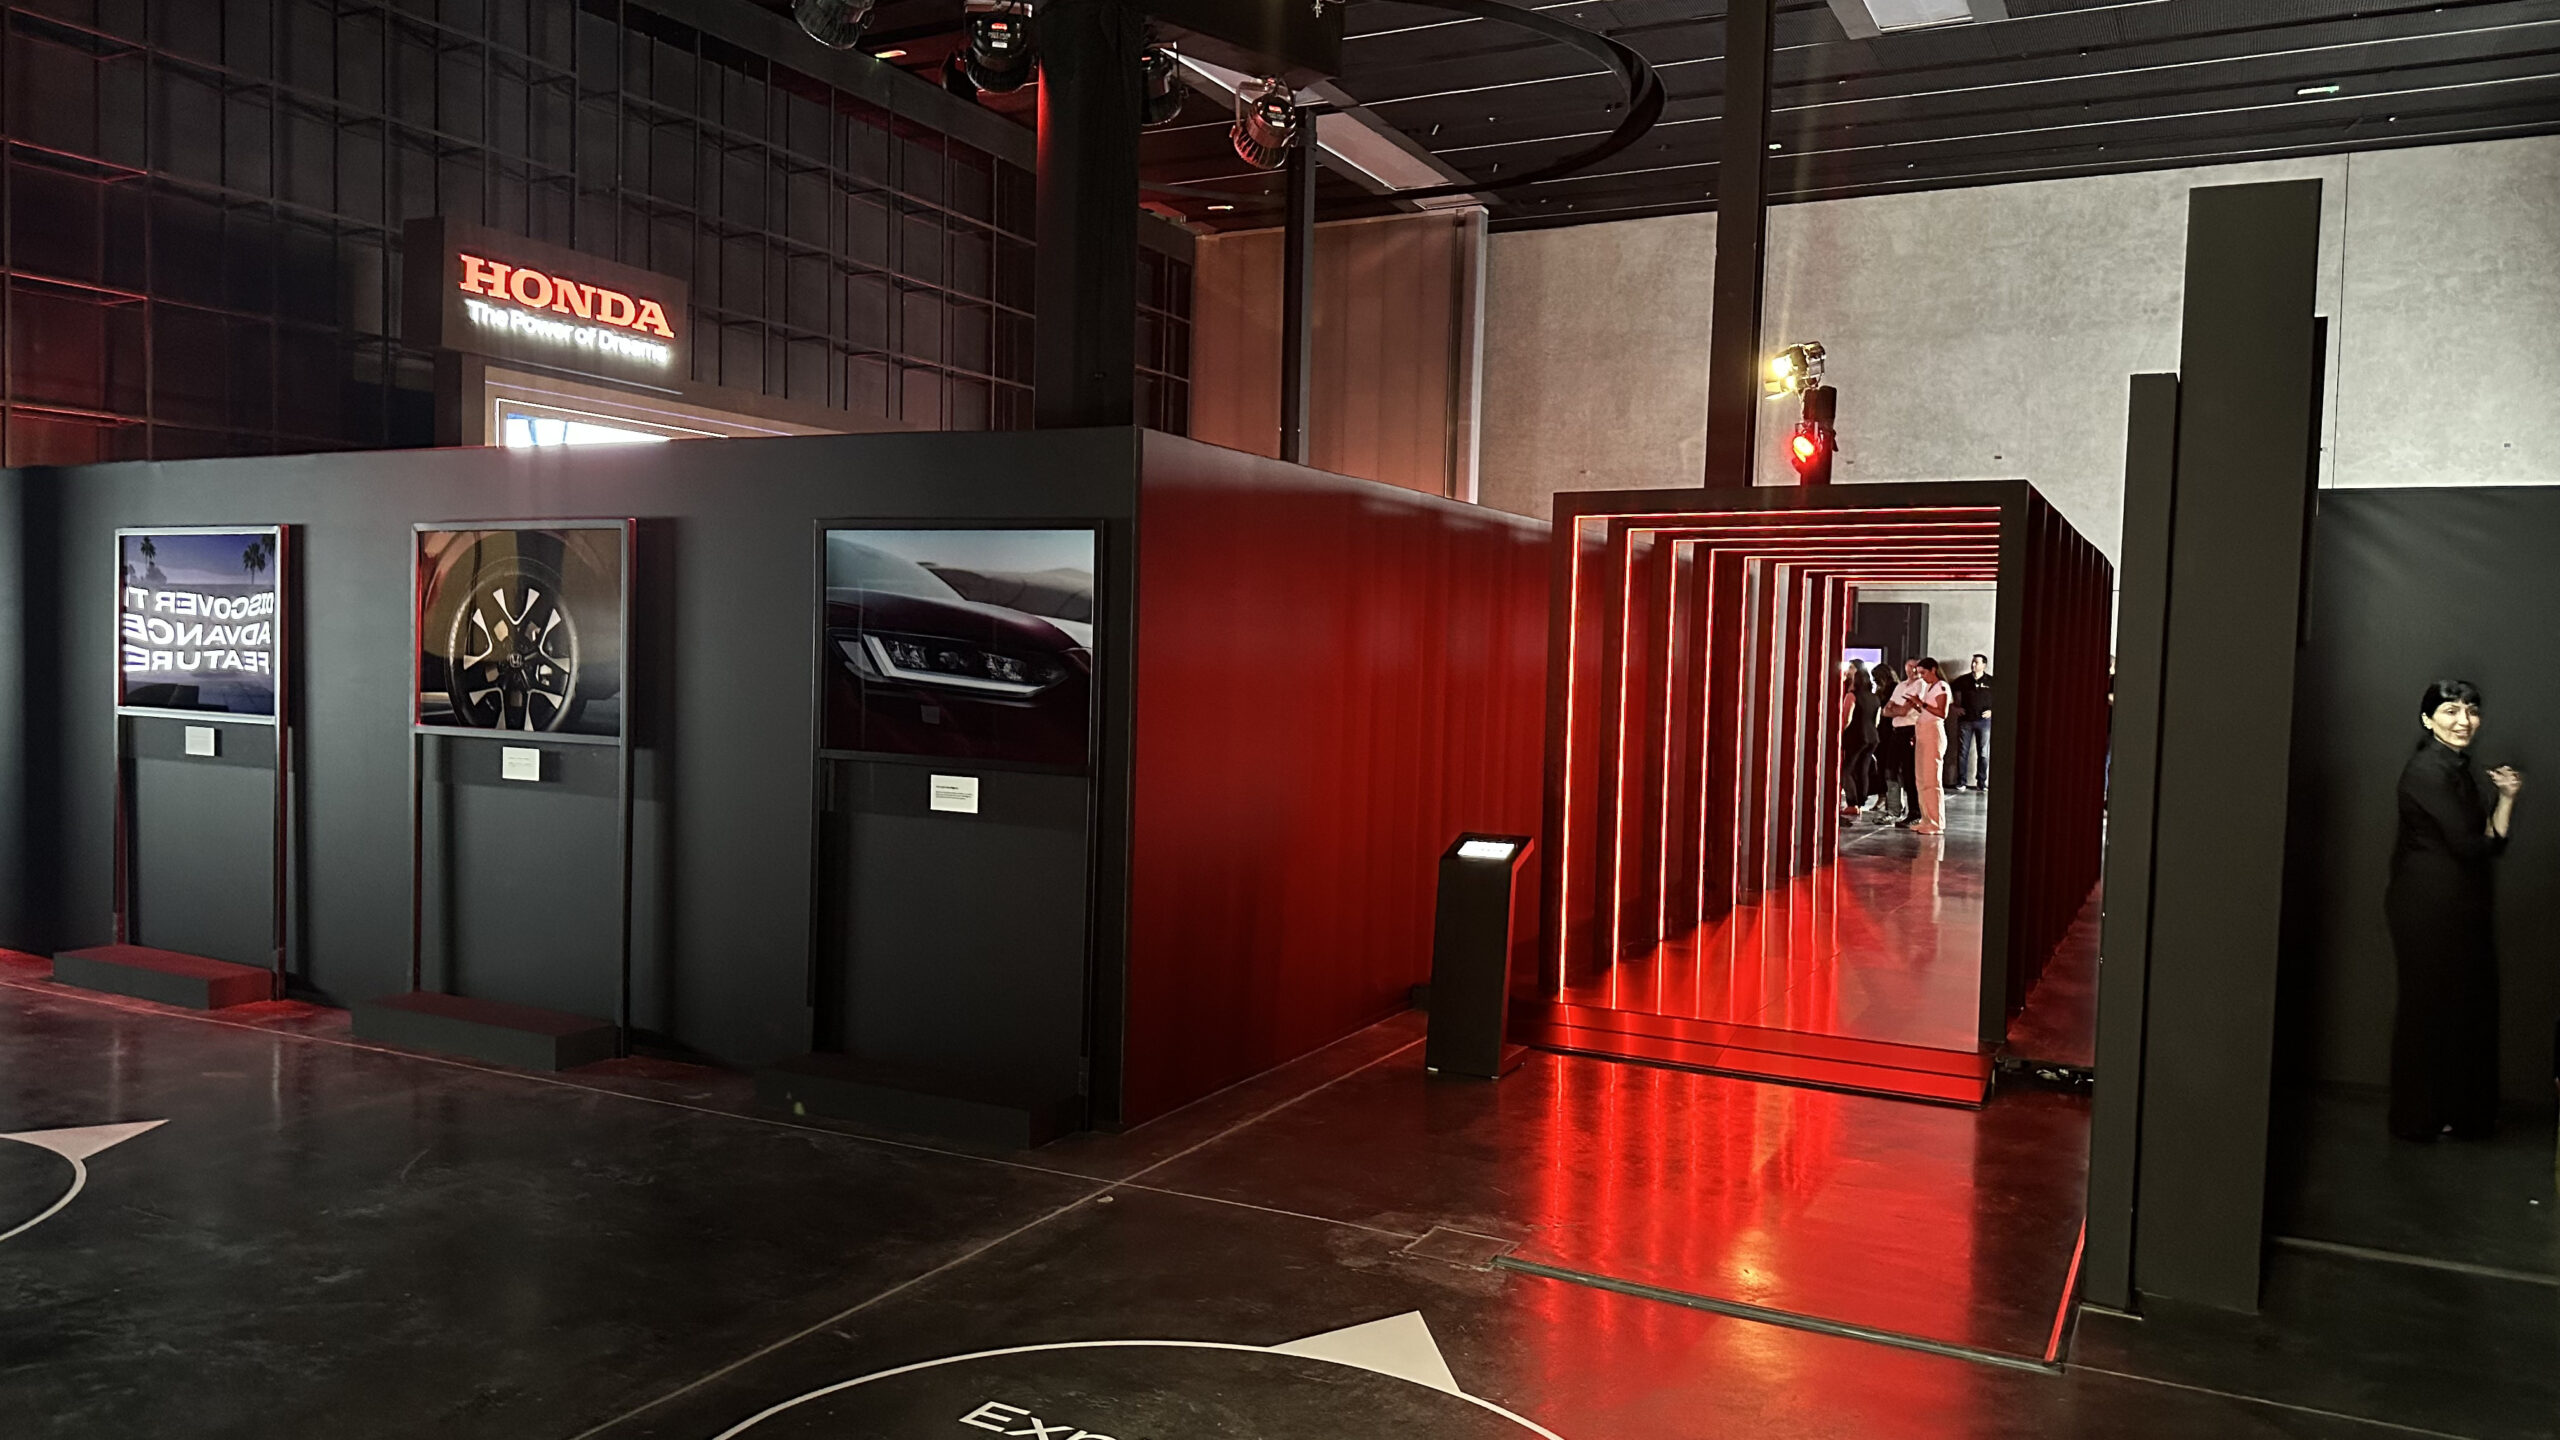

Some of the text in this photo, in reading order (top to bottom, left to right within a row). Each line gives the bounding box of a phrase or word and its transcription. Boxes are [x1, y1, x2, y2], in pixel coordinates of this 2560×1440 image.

[458, 253, 675, 339] HONDA
[465, 299, 509, 329] The
[510, 308, 574, 342] Power
[574, 326, 597, 348] of
